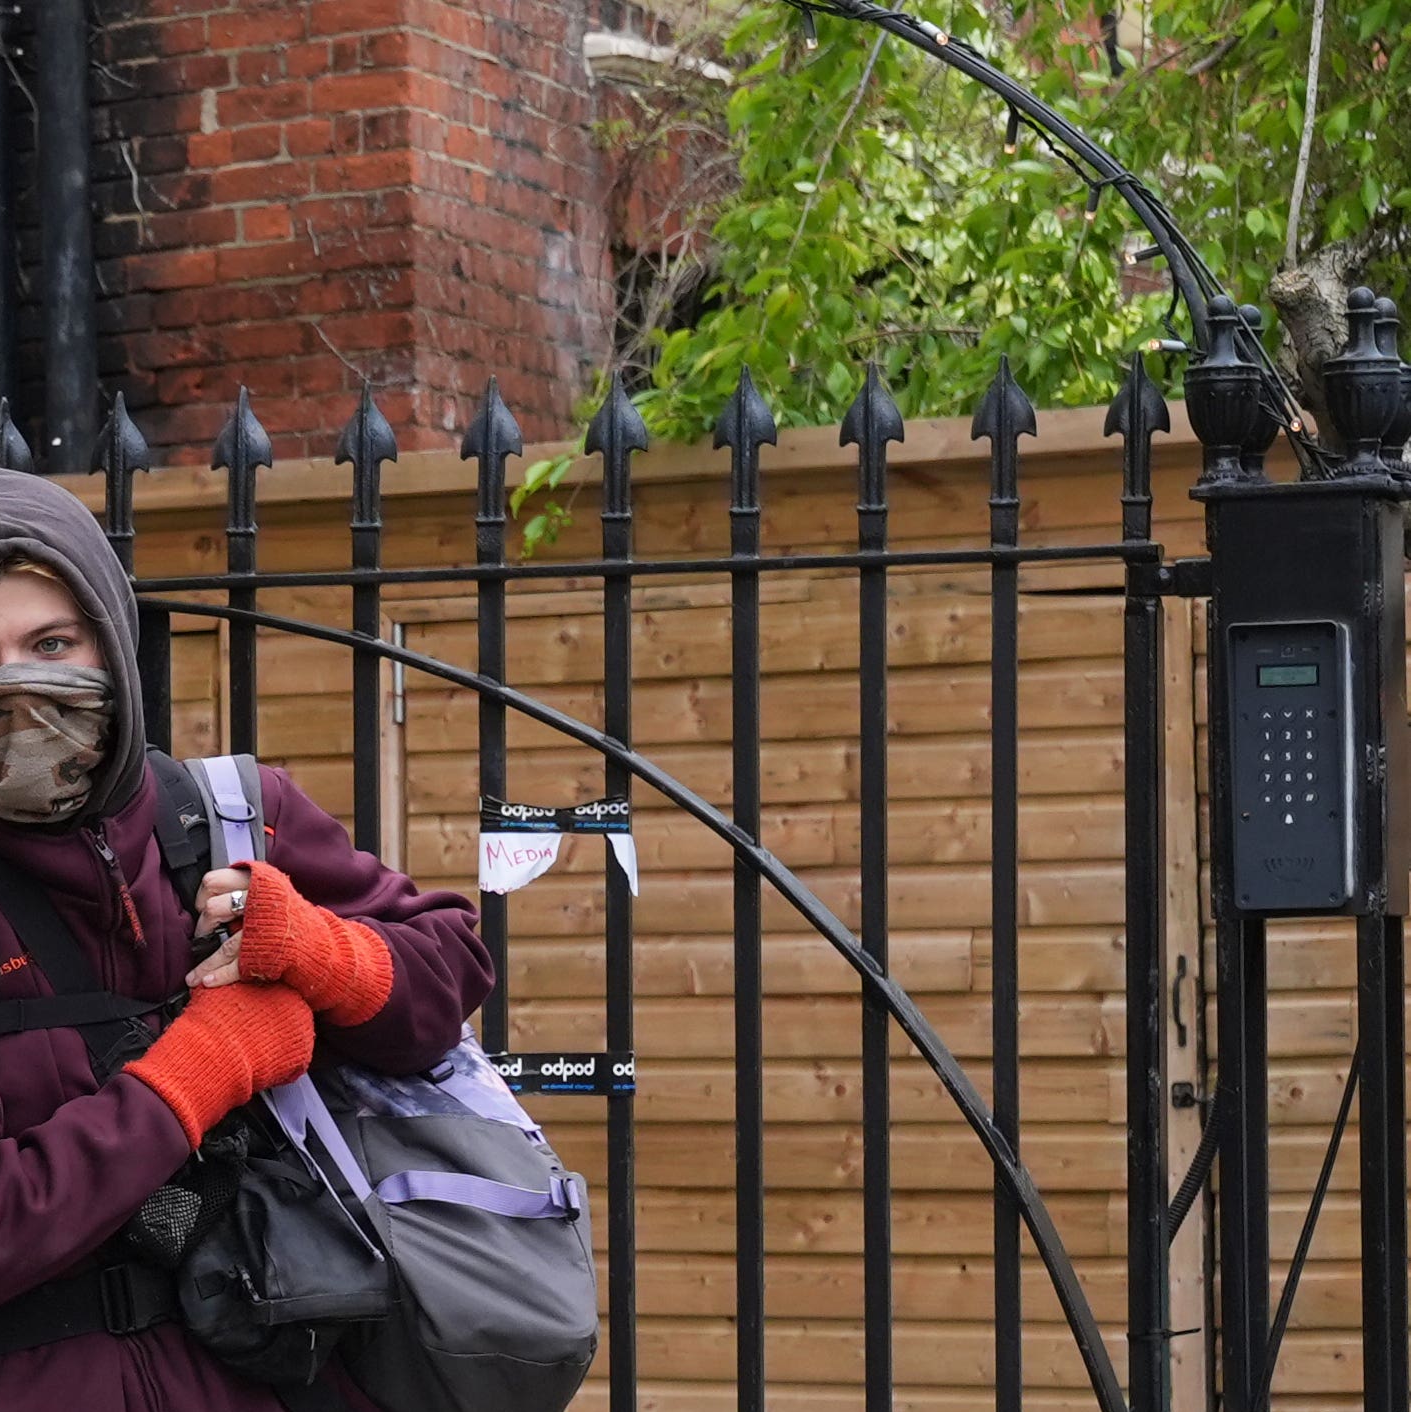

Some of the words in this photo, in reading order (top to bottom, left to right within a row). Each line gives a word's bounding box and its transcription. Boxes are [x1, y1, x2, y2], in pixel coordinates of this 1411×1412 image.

[486, 839, 553, 870] MEDIA
[540, 1057, 595, 1082] odpod
[612, 1057, 636, 1082] od
